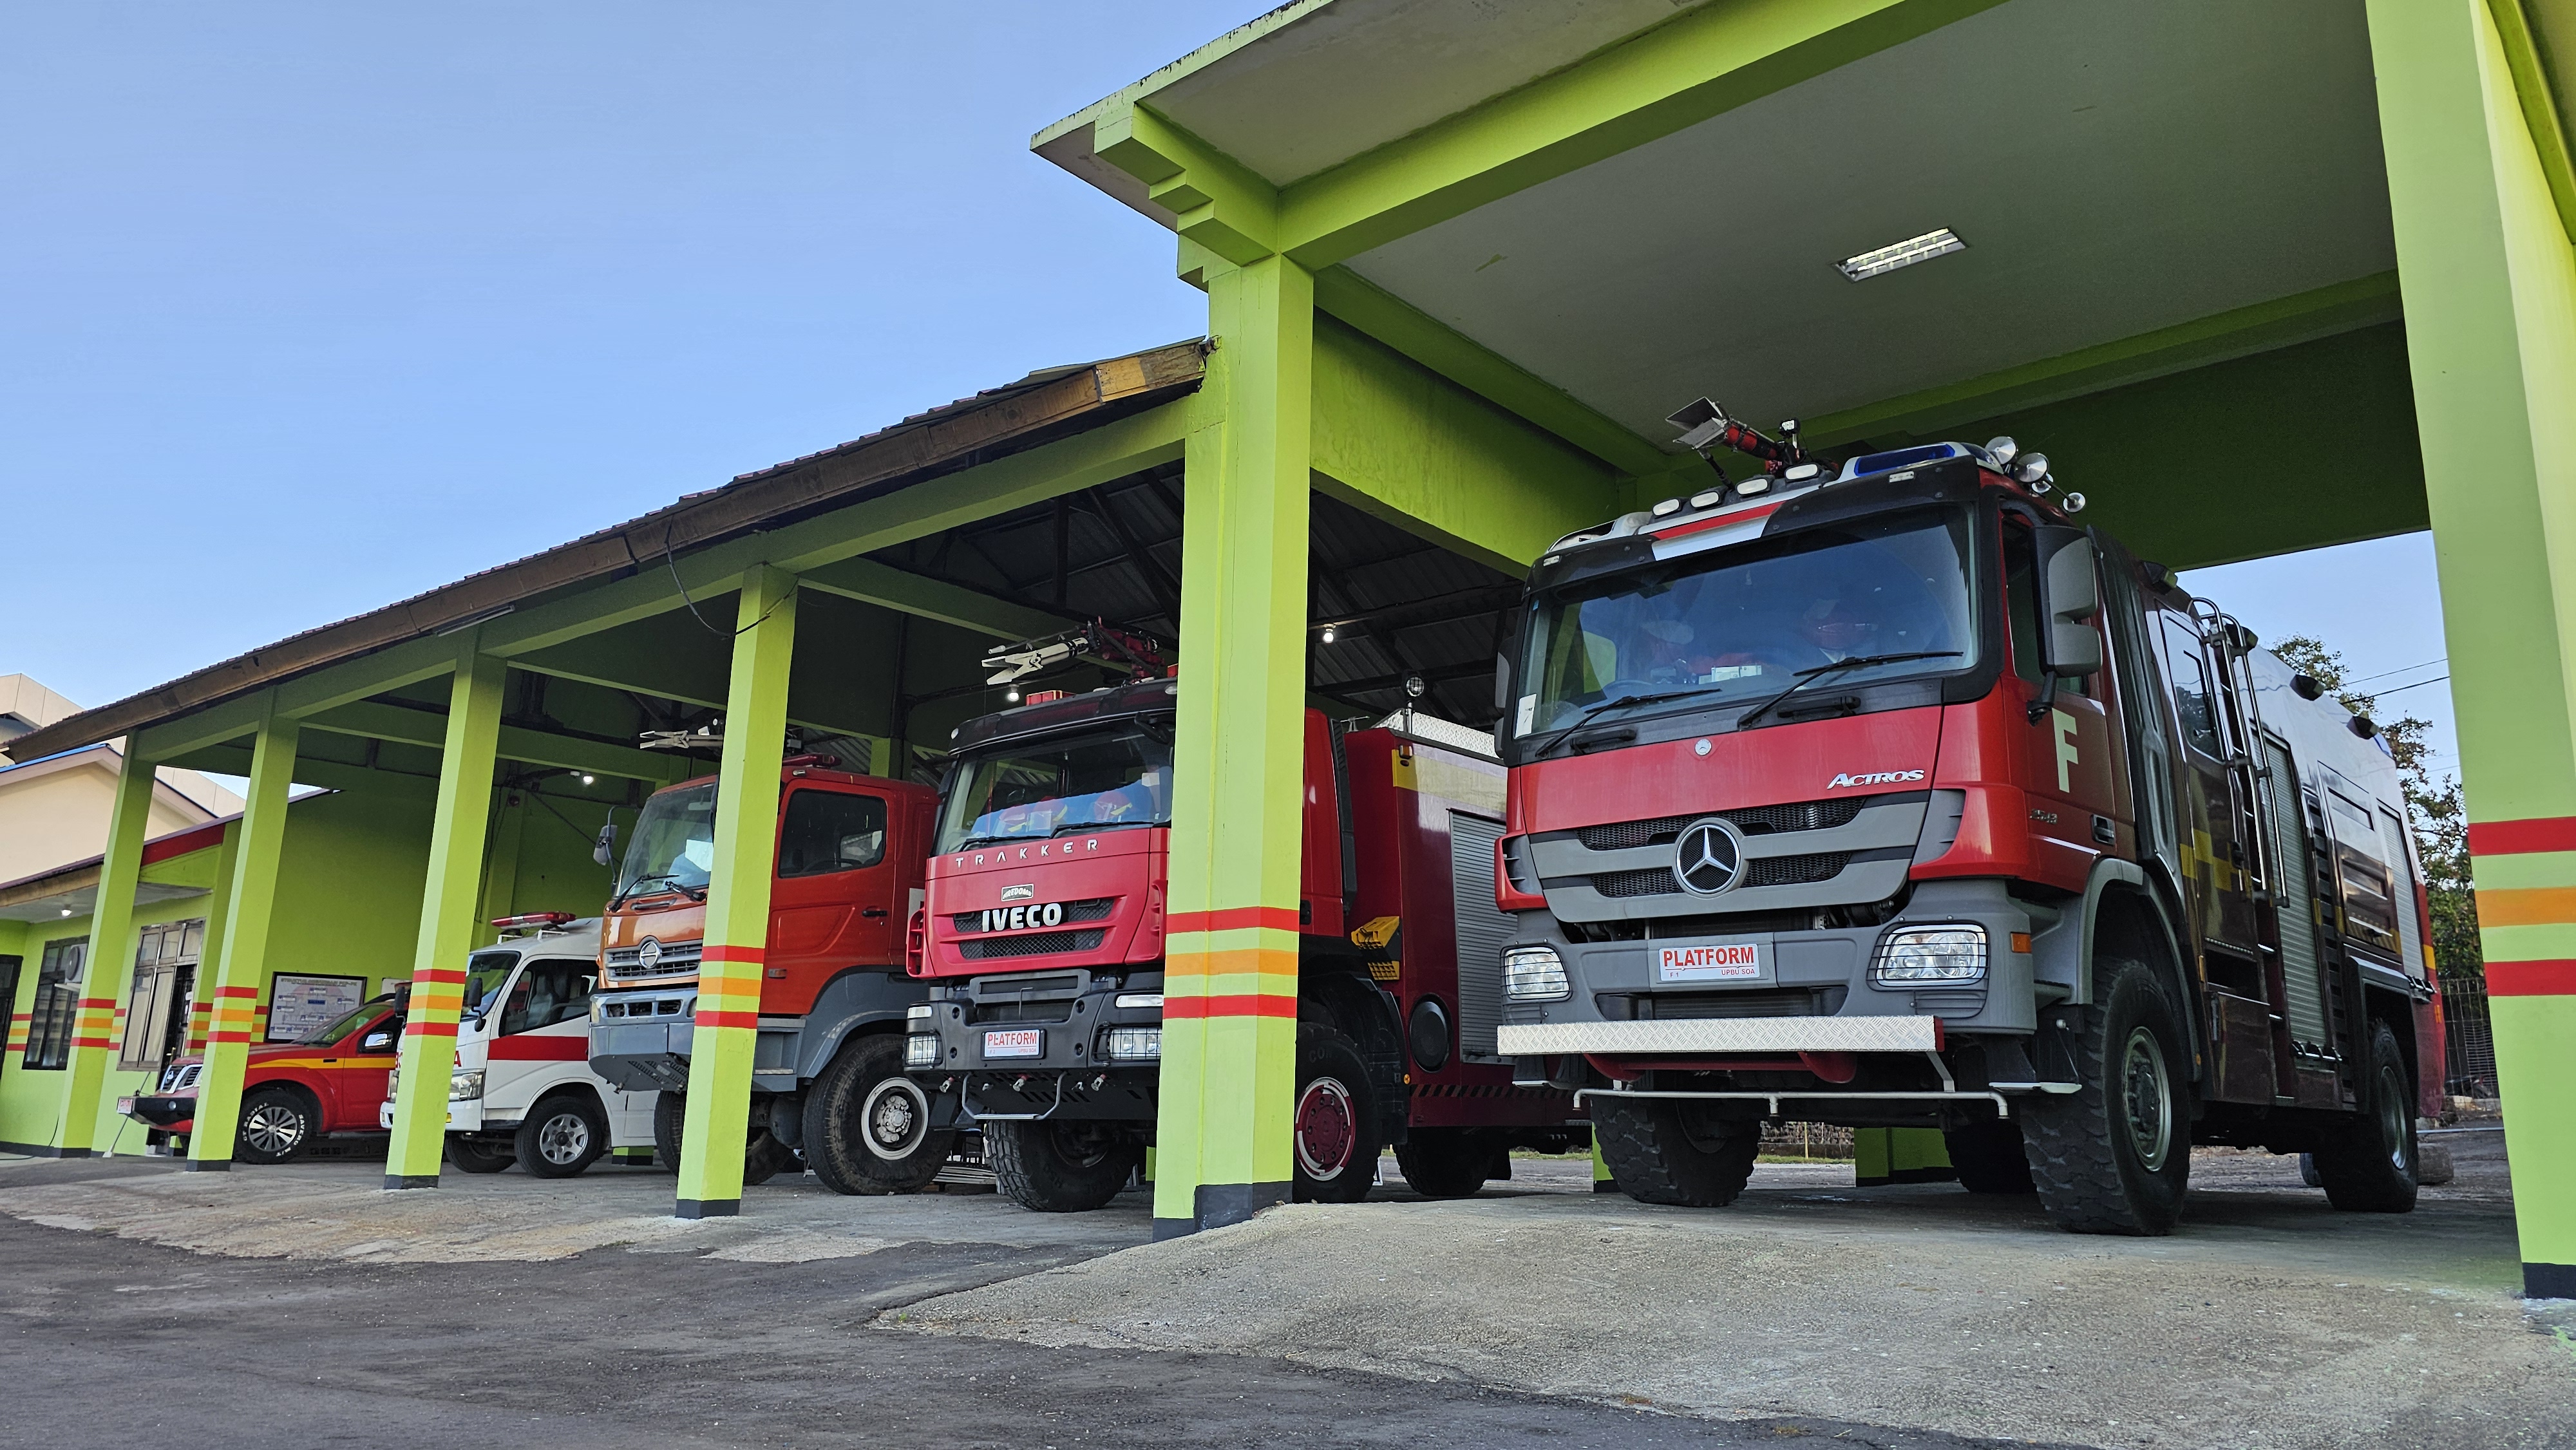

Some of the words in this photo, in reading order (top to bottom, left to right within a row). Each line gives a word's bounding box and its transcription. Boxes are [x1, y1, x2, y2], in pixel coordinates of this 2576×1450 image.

[2051, 708, 2079, 793] F
[1826, 769, 1925, 790] ACTROS
[955, 839, 1098, 869] TRAKKER
[982, 903, 1062, 933] IVECO
[1663, 946, 1754, 967] PLATFORM
[988, 1032, 1037, 1046] PLATFORM
[294, 1115, 305, 1145] SAVERO
